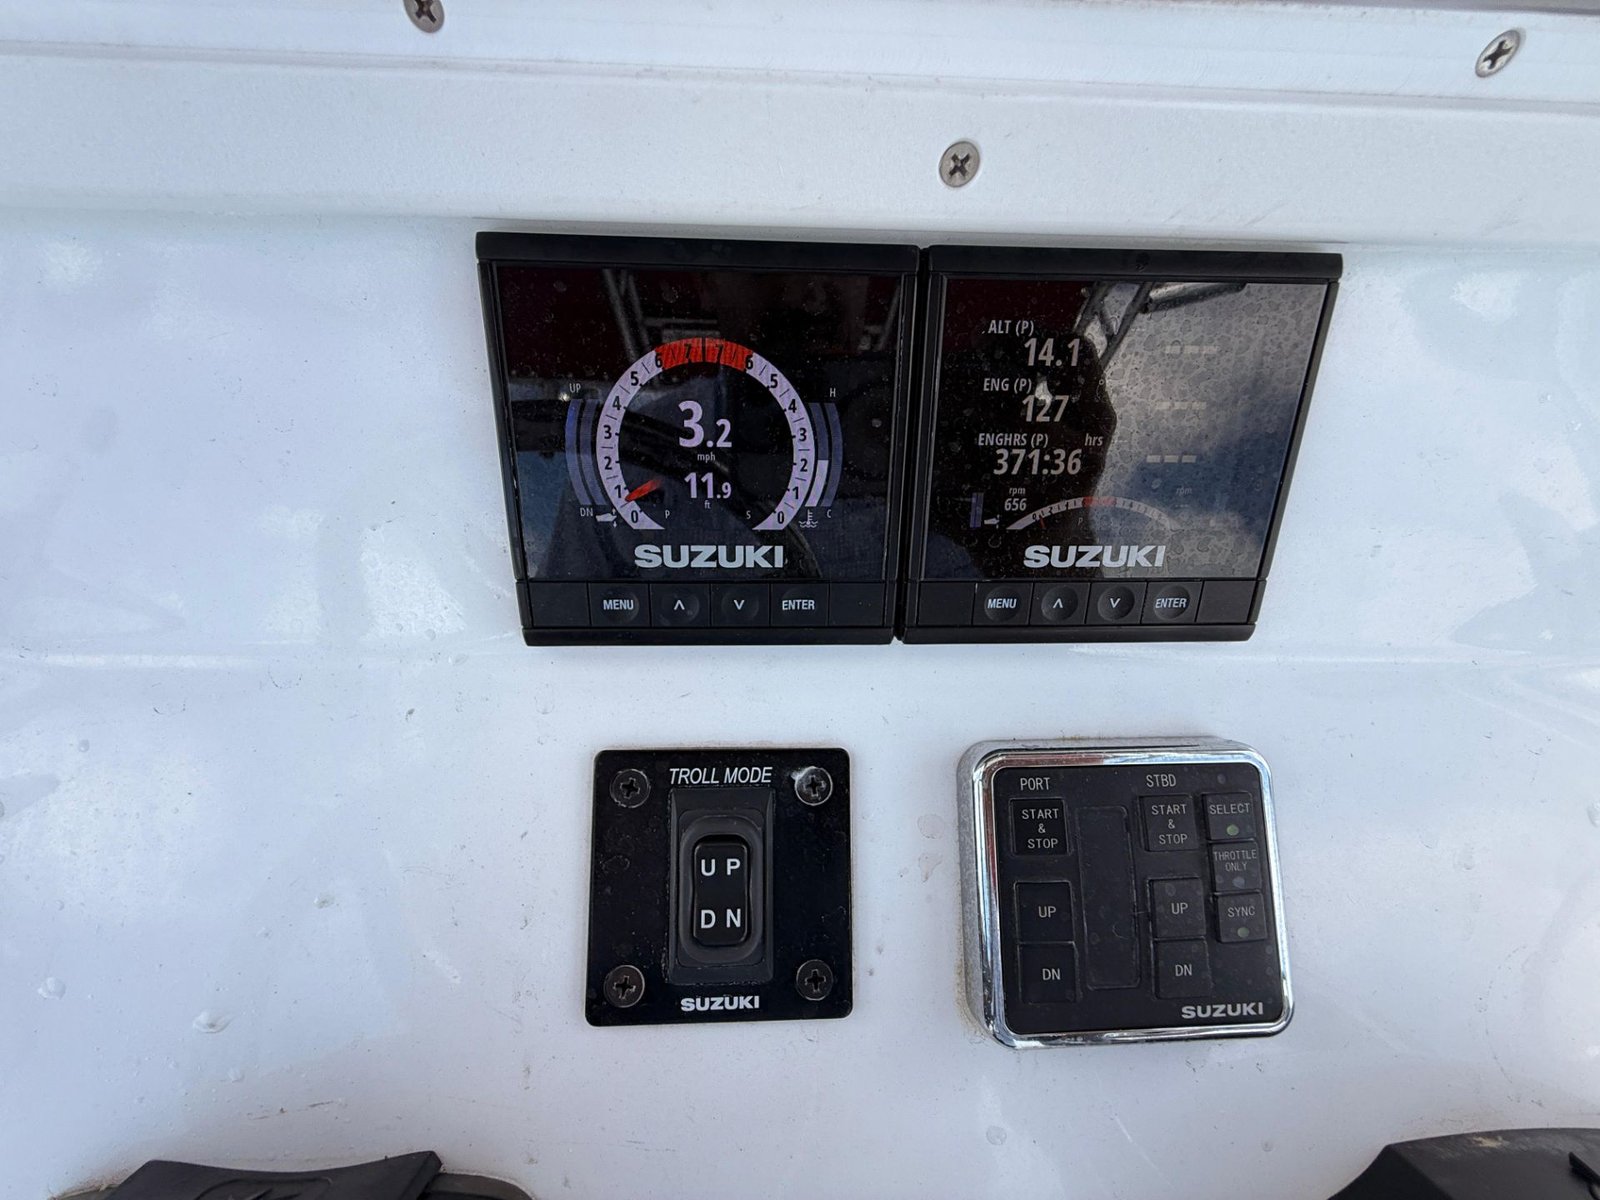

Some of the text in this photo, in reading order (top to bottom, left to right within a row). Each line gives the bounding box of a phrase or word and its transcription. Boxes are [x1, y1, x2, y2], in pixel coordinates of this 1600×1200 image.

[988, 320, 1034, 336] ALT (P)
[1024, 338, 1080, 367] 14.1
[654, 354, 663, 368] 6
[746, 355, 754, 370] 6
[630, 371, 639, 386] 5
[770, 373, 778, 388] 5
[569, 383, 581, 393] UP
[829, 387, 836, 398] H
[983, 378, 1032, 394] ENG (P)
[612, 396, 621, 410] 4
[788, 399, 797, 413] 4
[1022, 395, 1069, 422] 127
[678, 400, 732, 448] 3.2
[603, 425, 612, 439] 3
[799, 427, 807, 441] 3
[978, 433, 1103, 448] ENGHRS (P) hrs
[604, 456, 612, 470] 2
[697, 452, 716, 463] mph
[993, 449, 1082, 475] 371:36
[800, 458, 808, 472] 2
[614, 485, 622, 498] 1
[684, 472, 732, 499] 11.9
[1008, 487, 1026, 496] rpm
[792, 486, 799, 500] 1
[704, 500, 711, 509] ft
[1004, 498, 1027, 512] 656
[580, 508, 593, 517] DN
[630, 510, 638, 523] 0
[665, 509, 671, 519] P
[746, 510, 751, 519] S
[777, 510, 784, 524] 0
[826, 509, 832, 518] C
[634, 544, 784, 568] SUZUKI
[1023, 545, 1166, 568] SUZUKI
[603, 599, 634, 611] MENU
[782, 599, 815, 611] ENTER
[987, 597, 1017, 610] MENU
[1155, 597, 1187, 610] ENTER
[669, 767, 773, 785] TROLL MODE
[1146, 774, 1176, 787] STBD
[1020, 777, 1050, 790] PORT
[1021, 808, 1059, 820] START
[1151, 804, 1187, 815] START
[1209, 803, 1250, 814] SELECT
[1037, 823, 1046, 833] &
[1167, 819, 1176, 829] &
[1027, 838, 1058, 849] STOP
[1158, 833, 1188, 844] STOP
[1213, 850, 1257, 861] THROTTLE
[700, 859, 741, 876] UP
[1225, 861, 1248, 872] ONLY
[1038, 906, 1056, 918] UP
[1171, 903, 1188, 914] UP
[1227, 906, 1255, 917] SYNC
[700, 908, 741, 928] DN
[1042, 968, 1061, 980] DN
[1175, 964, 1192, 976] DN
[681, 996, 760, 1012] SUZUKI
[1181, 1002, 1264, 1019] SUZUKI
